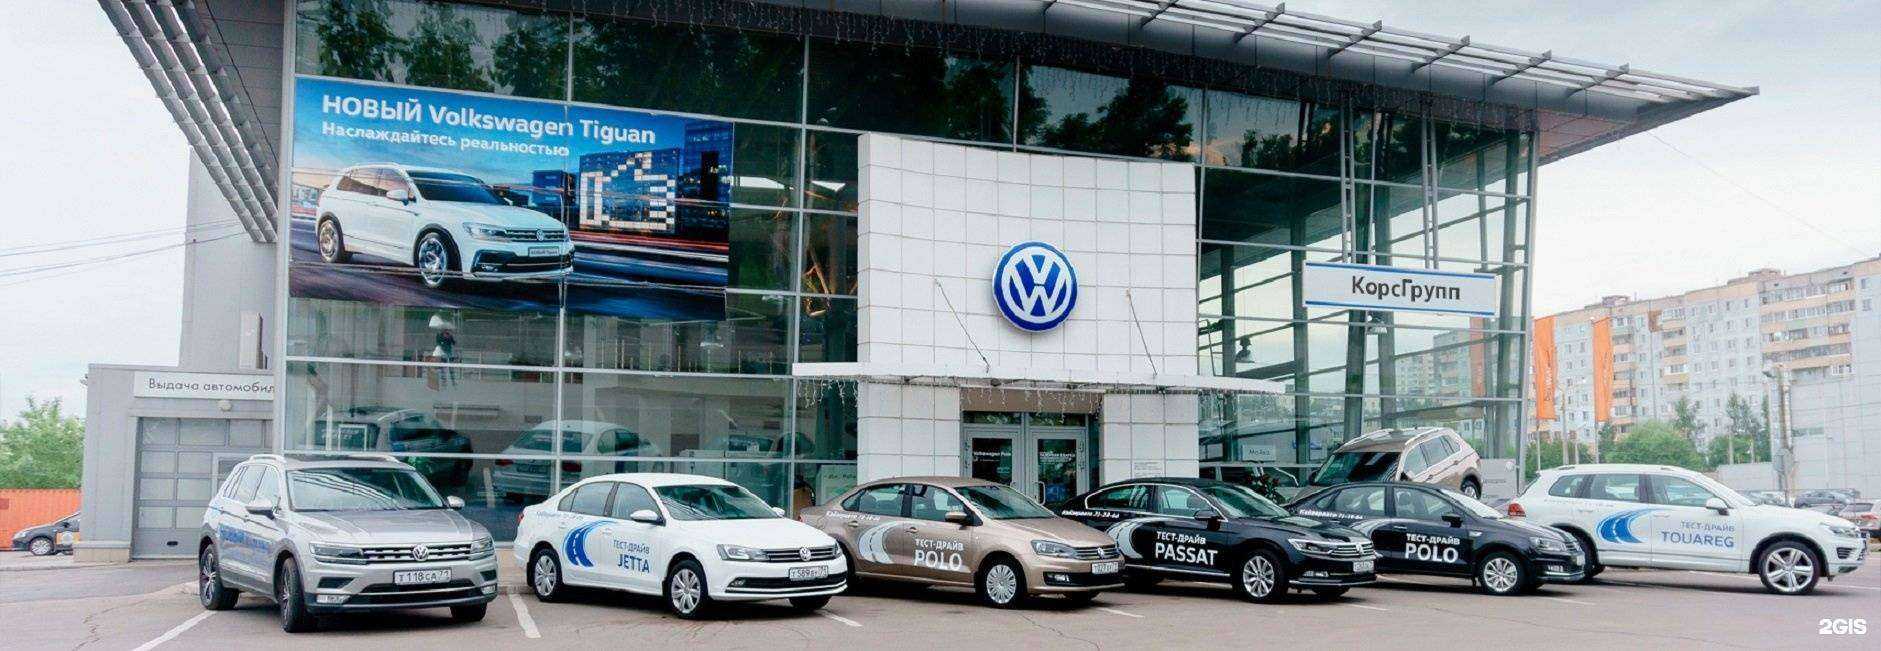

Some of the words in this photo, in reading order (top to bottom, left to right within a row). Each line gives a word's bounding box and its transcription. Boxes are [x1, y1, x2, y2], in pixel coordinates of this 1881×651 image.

[322, 95, 423, 122] НОВЫЙ
[429, 104, 574, 138] Volkswagen
[580, 118, 656, 144] Tiguan
[322, 121, 456, 146] Наслаждайтесь
[460, 136, 570, 157] реальностью
[1352, 275, 1461, 302] КорсГрупп
[148, 377, 200, 392] Выдача
[1681, 521, 1736, 532] ТЕСТ-ДРАЙВ
[613, 540, 650, 554] ТЕСТ-ДРАЙВ
[915, 539, 964, 551] ТЕСТ-ДРАЙВ
[1156, 531, 1206, 545] ТЕСТ-ДРАЙВ
[1406, 533, 1460, 546] ТЕСТ-ДРАЙВ
[1661, 531, 1735, 549] TOUAREG
[914, 550, 962, 570] POLO
[1155, 542, 1218, 566] PASSAT
[1405, 543, 1459, 563] POLO
[617, 553, 650, 573] JETTA
